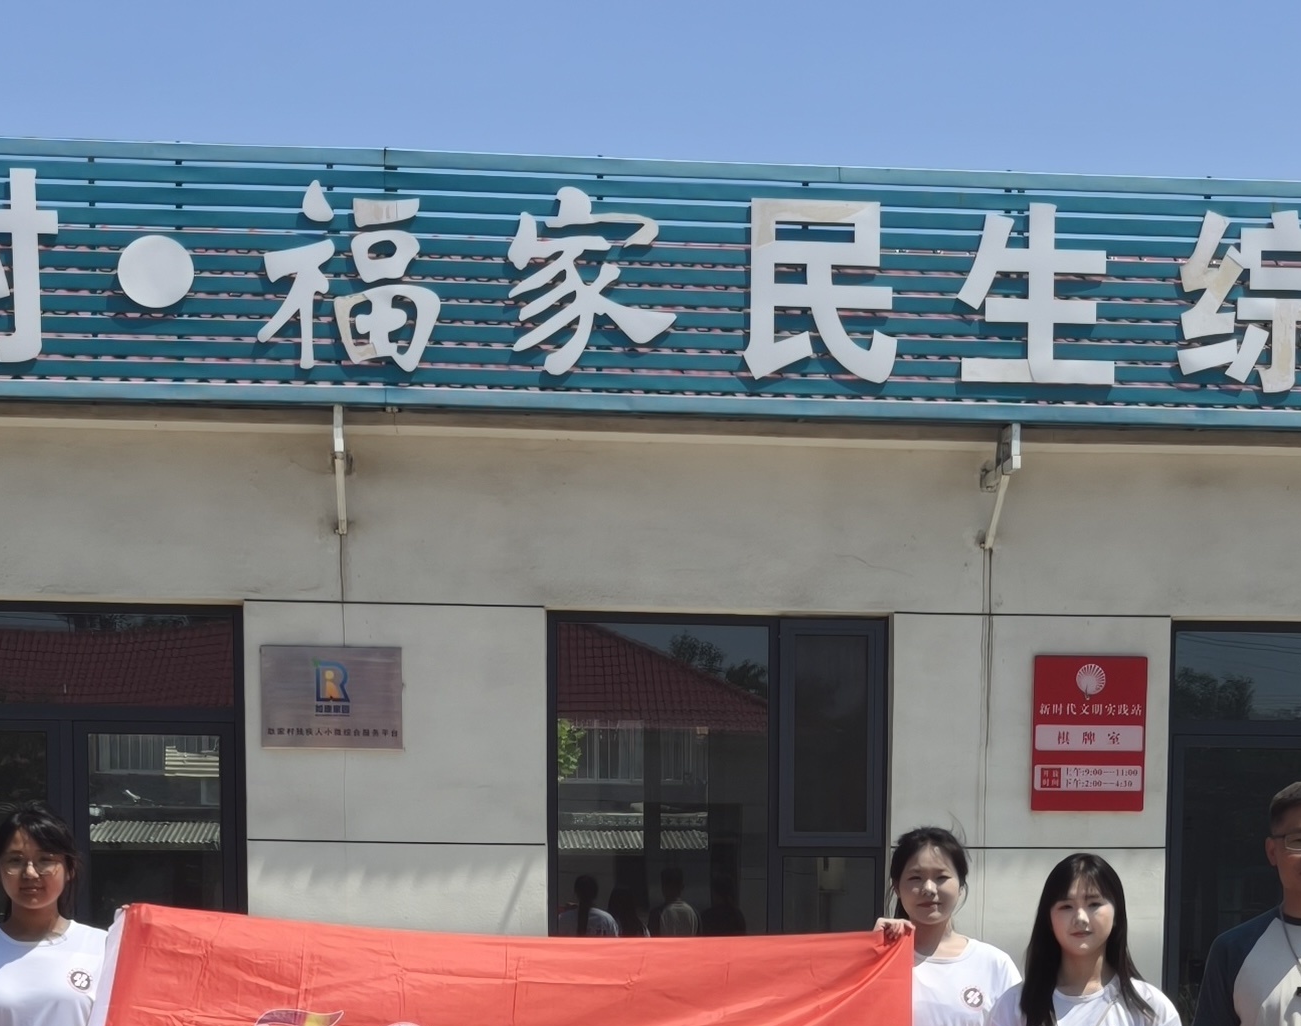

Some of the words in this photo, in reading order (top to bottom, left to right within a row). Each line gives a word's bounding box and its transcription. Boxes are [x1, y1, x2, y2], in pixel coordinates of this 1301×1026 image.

[1039, 703, 1142, 716] 新时代文明实践站
